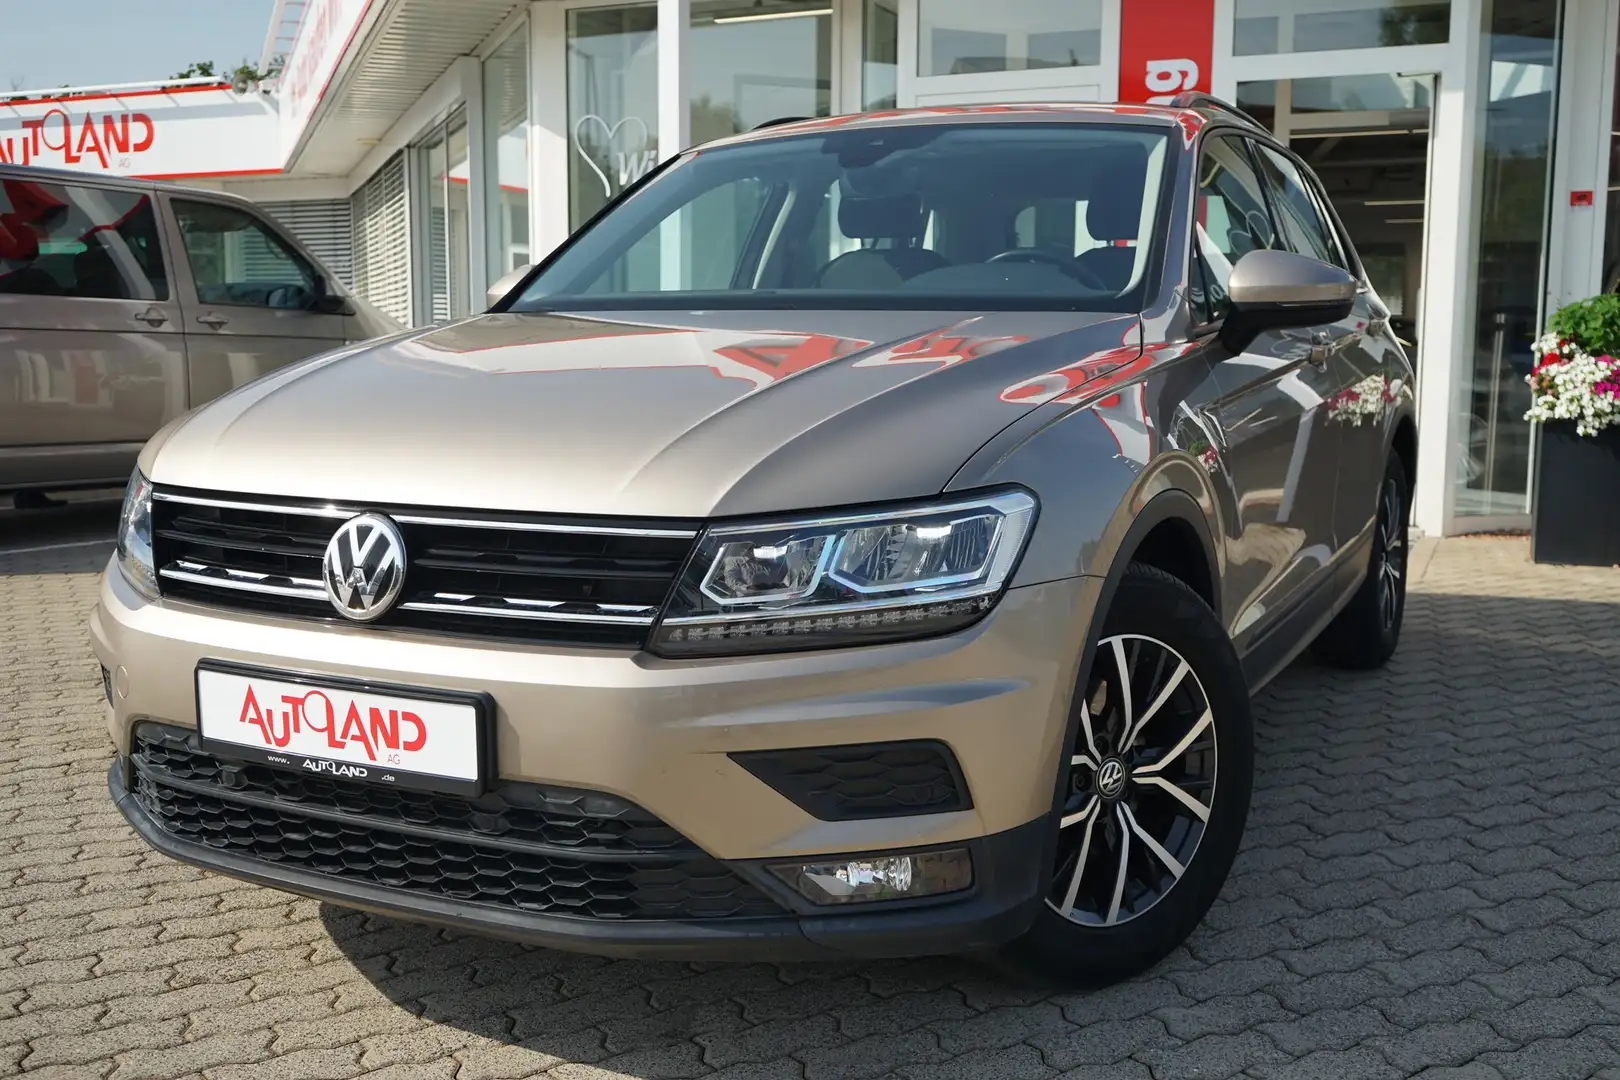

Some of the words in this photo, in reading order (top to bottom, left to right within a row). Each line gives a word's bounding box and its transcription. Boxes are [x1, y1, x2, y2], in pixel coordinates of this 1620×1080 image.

[267, 755, 290, 764] www.
[381, 774, 395, 782] .de
[387, 754, 401, 765] AG
